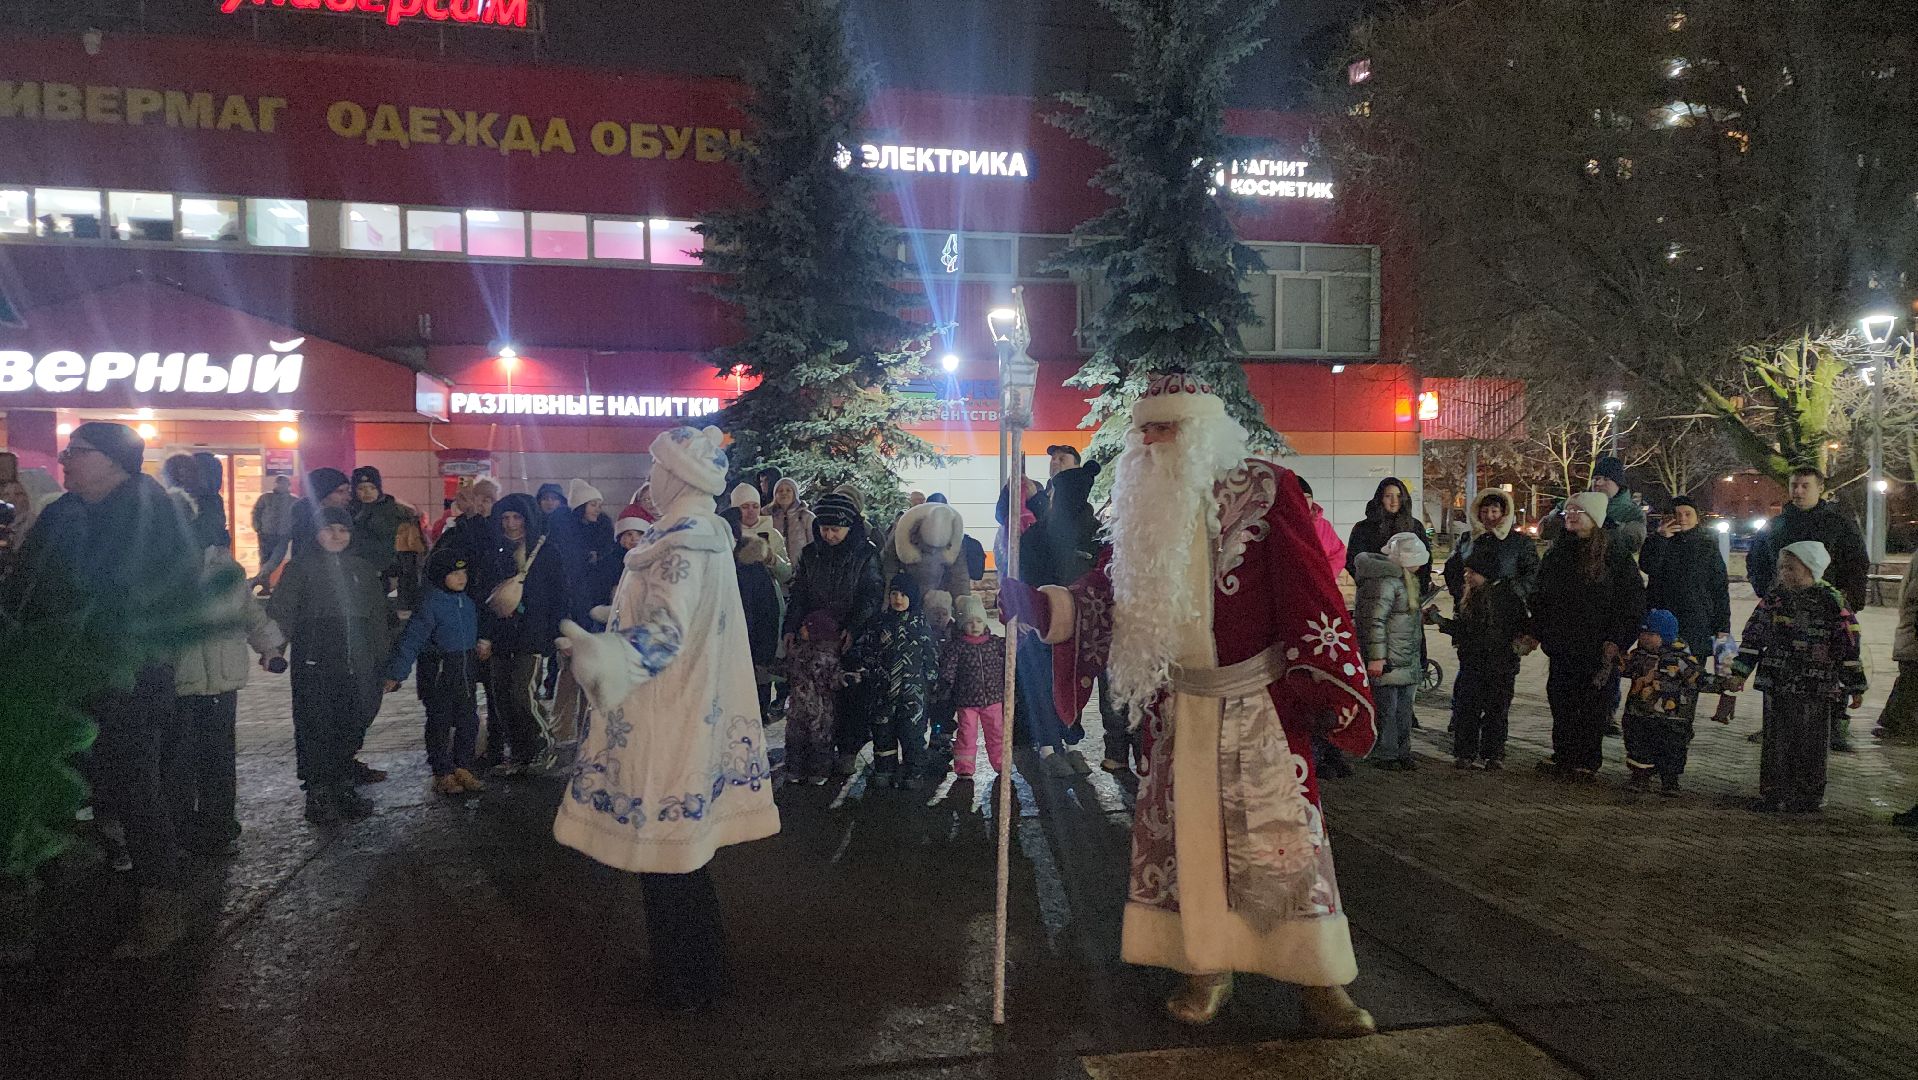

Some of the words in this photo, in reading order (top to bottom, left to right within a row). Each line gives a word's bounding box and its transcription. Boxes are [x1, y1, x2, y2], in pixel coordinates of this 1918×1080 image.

[327, 101, 576, 157] ОДЕЖДА
[861, 144, 1028, 177] ЭЛЕКТРИКА
[1231, 179, 1334, 199] КОСМЕТИК
[451, 392, 605, 415] РАЗЛИВНЫЕ
[608, 395, 719, 417] НАПИТКИ
